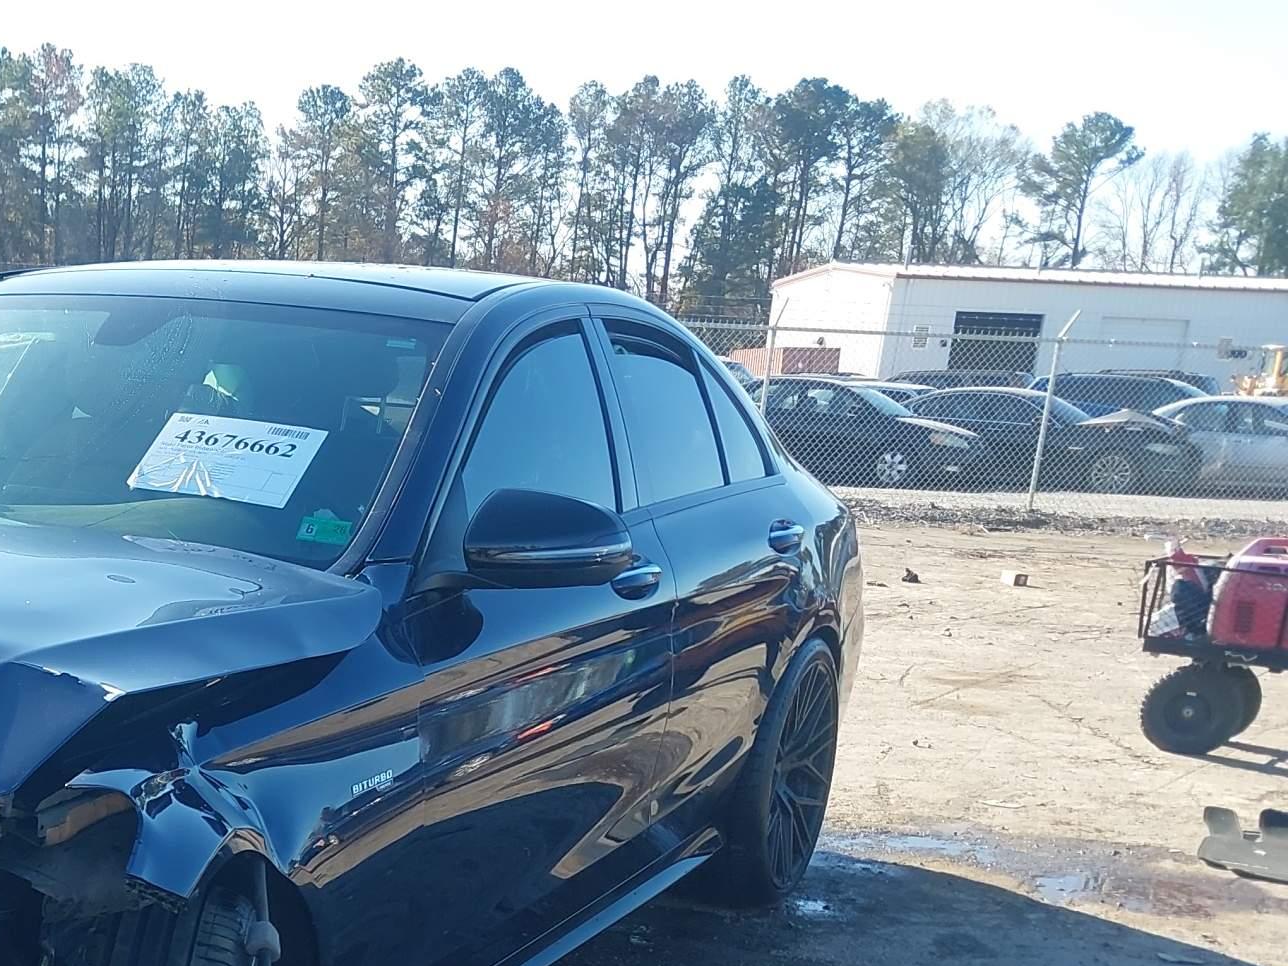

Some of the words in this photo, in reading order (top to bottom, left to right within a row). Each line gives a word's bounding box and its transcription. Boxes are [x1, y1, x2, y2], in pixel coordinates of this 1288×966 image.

[175, 429, 297, 458] 43676662
[305, 523, 315, 534] 6
[352, 769, 393, 794] BITURBO
